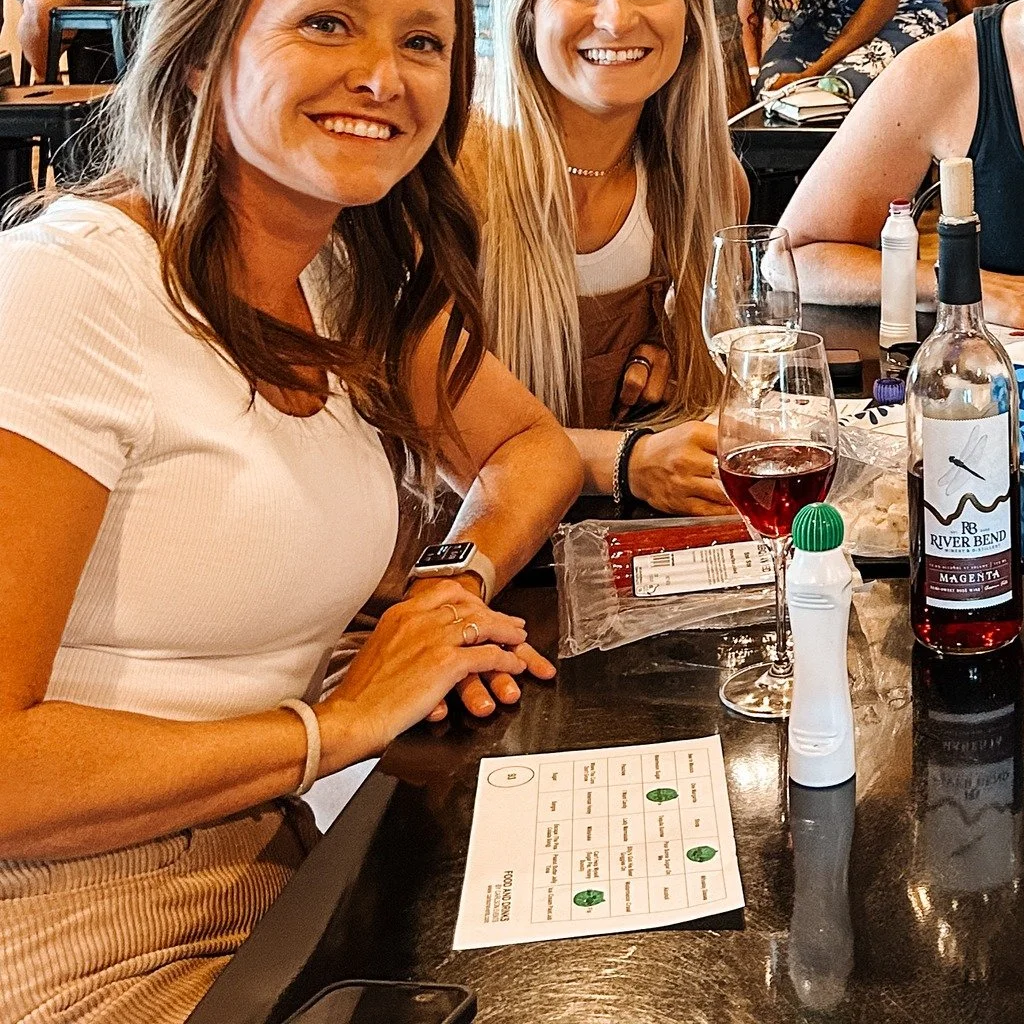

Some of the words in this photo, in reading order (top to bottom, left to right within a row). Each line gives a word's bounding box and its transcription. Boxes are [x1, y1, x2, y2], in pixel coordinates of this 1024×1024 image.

[930, 533, 971, 550] RIVER
[974, 529, 1007, 547] BEND
[939, 569, 1001, 583] MAGENTA
[502, 869, 513, 888] FOOD
[501, 887, 512, 901] AND
[499, 901, 511, 922] DRINKS
